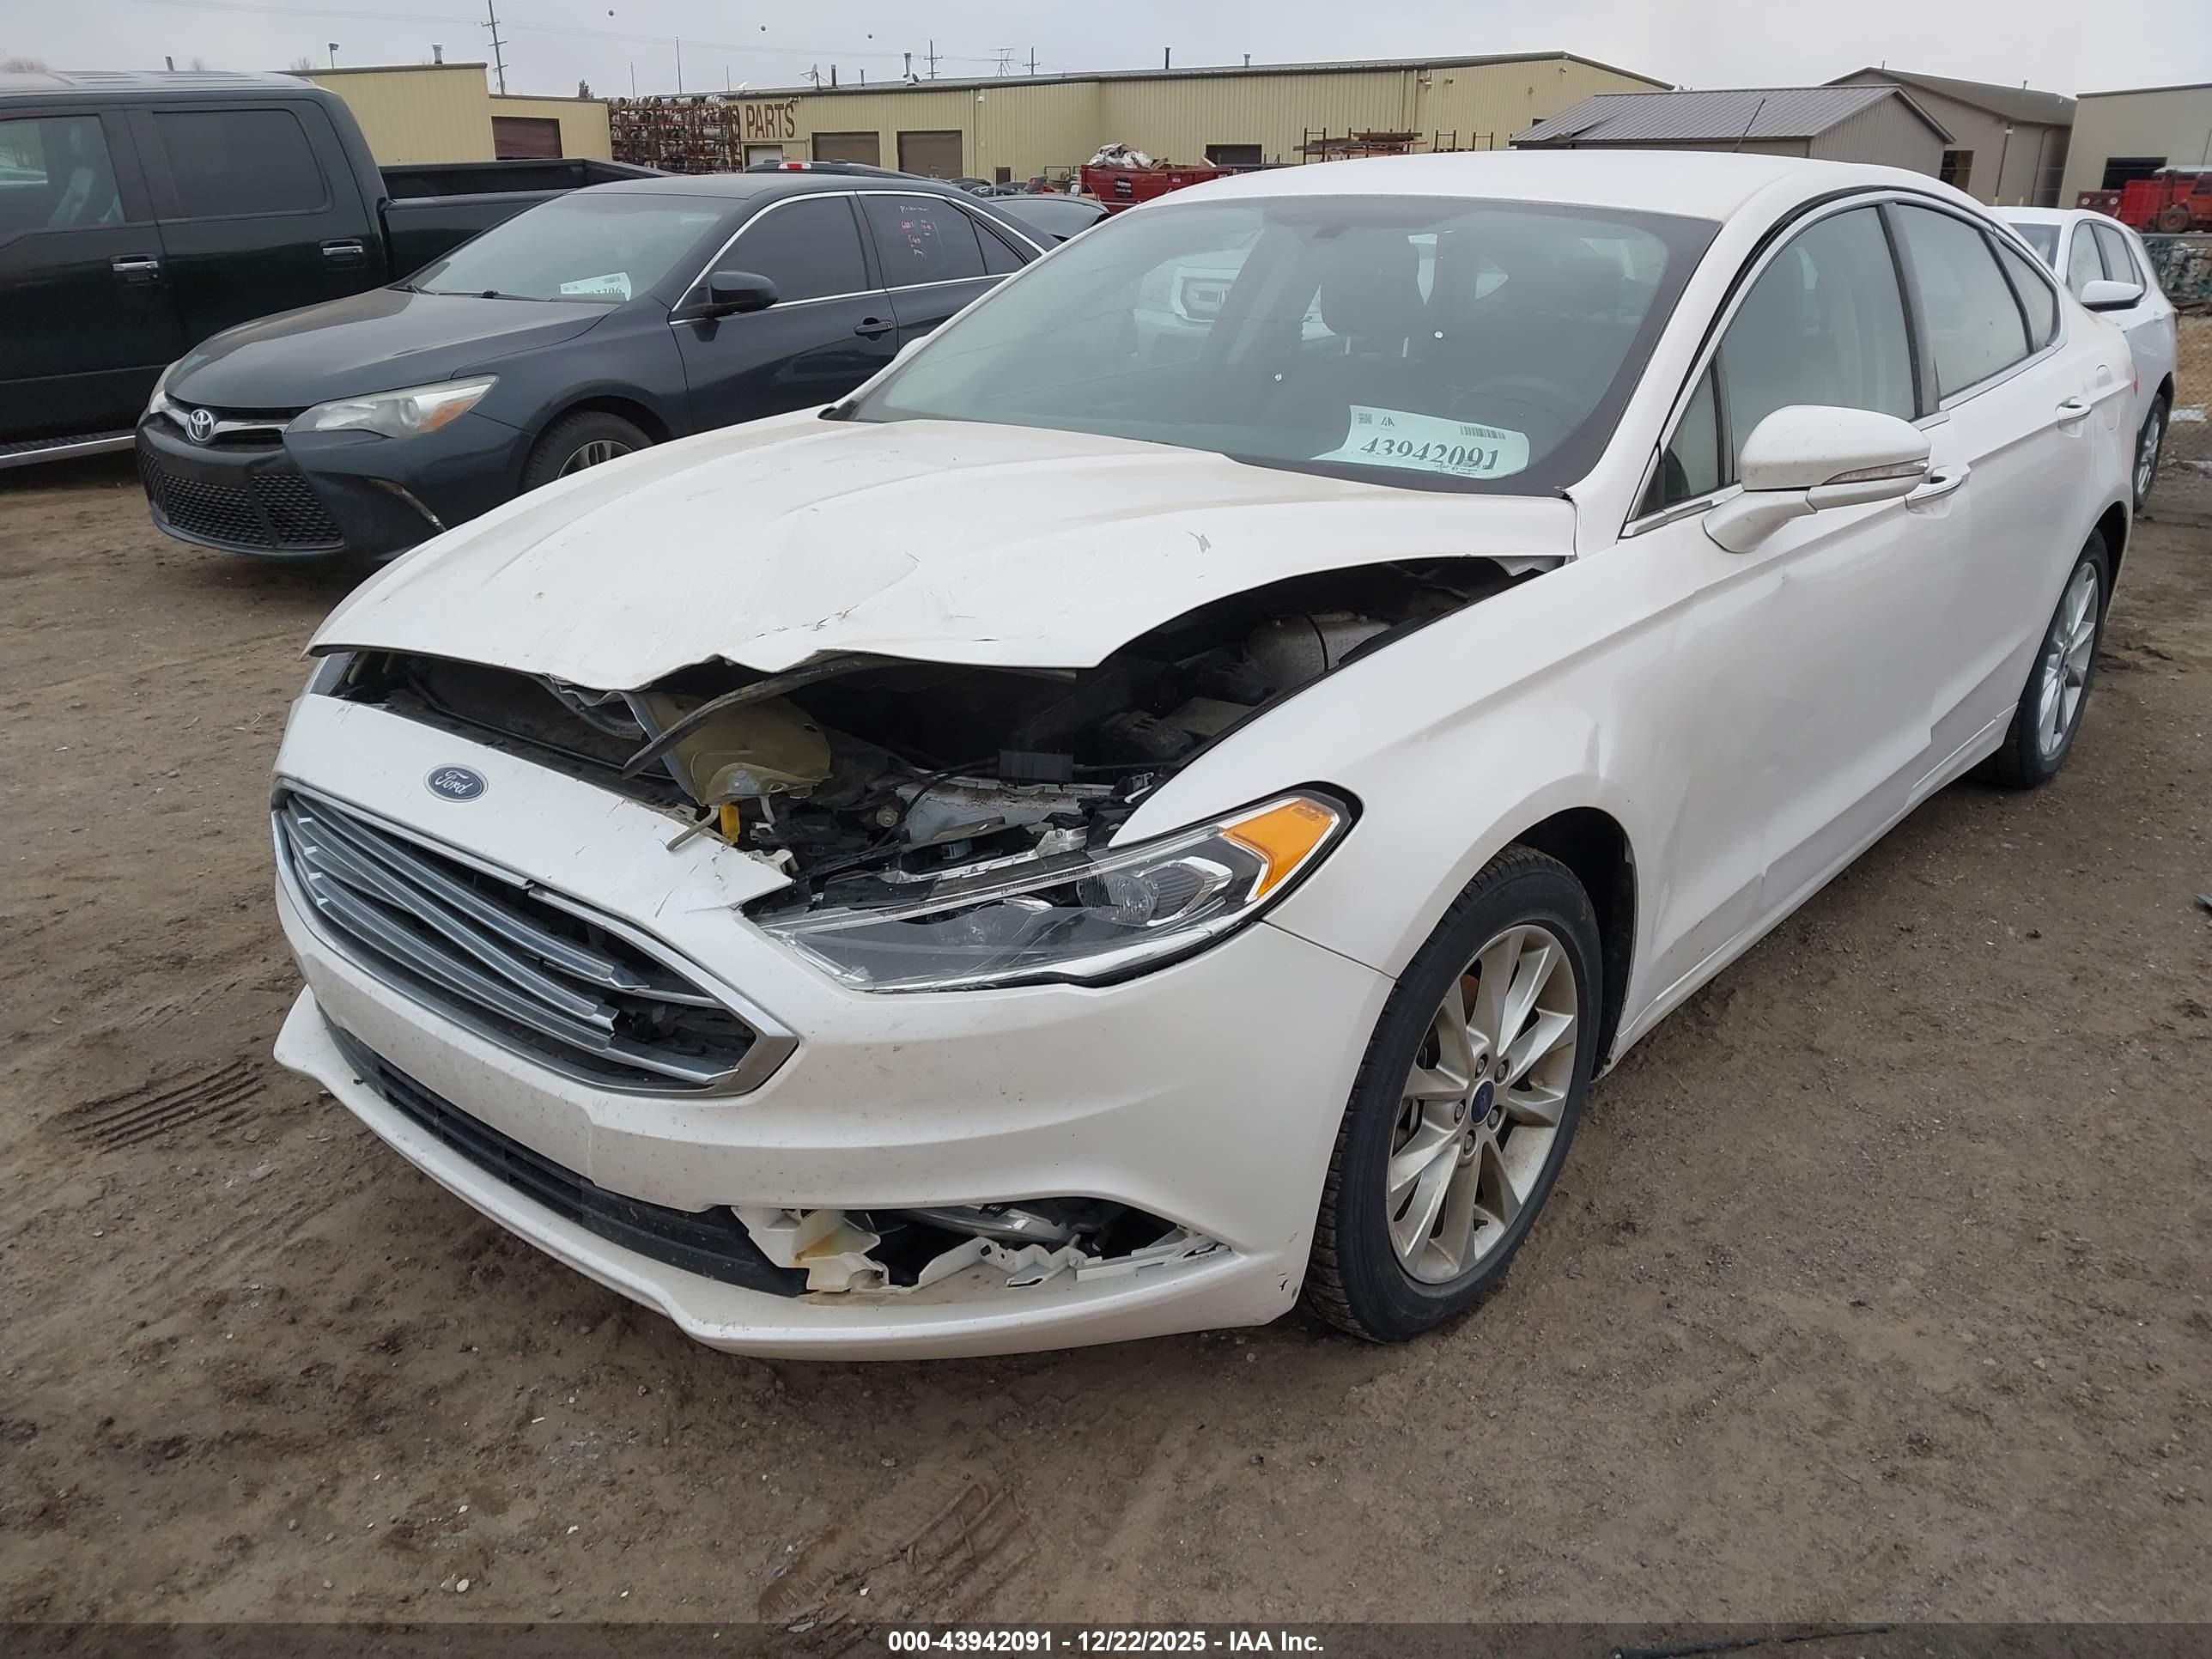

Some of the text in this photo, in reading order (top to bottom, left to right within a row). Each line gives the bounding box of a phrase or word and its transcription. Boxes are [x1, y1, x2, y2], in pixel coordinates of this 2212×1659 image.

[745, 102, 795, 138] PARTS
[1359, 437, 1499, 471] 43942091
[434, 770, 474, 795] Ford
